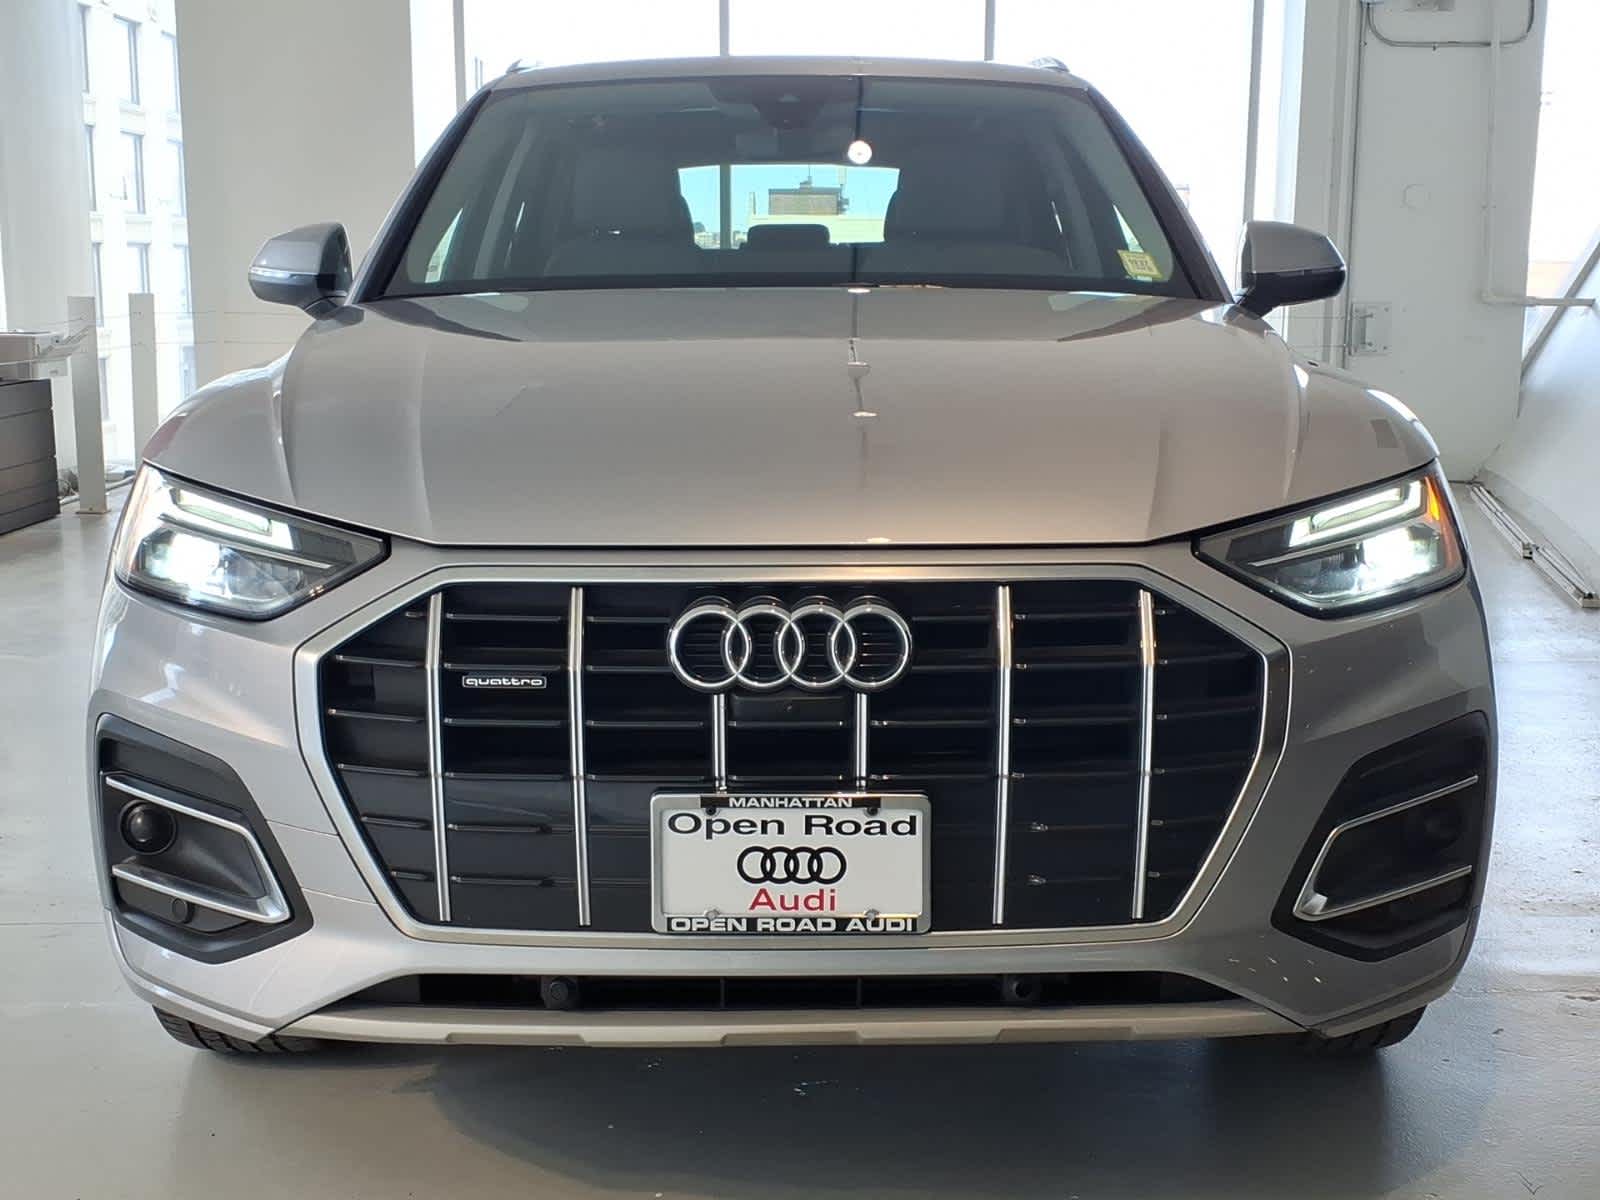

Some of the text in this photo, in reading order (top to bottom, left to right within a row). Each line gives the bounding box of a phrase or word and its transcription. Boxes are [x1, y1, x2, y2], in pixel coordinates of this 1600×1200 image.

[465, 677, 543, 687] quattro
[728, 797, 853, 808] MANHATTAN
[668, 812, 917, 840] Open Road
[749, 888, 836, 912] Audi
[670, 917, 913, 932] OPEN ROAD AUDI
